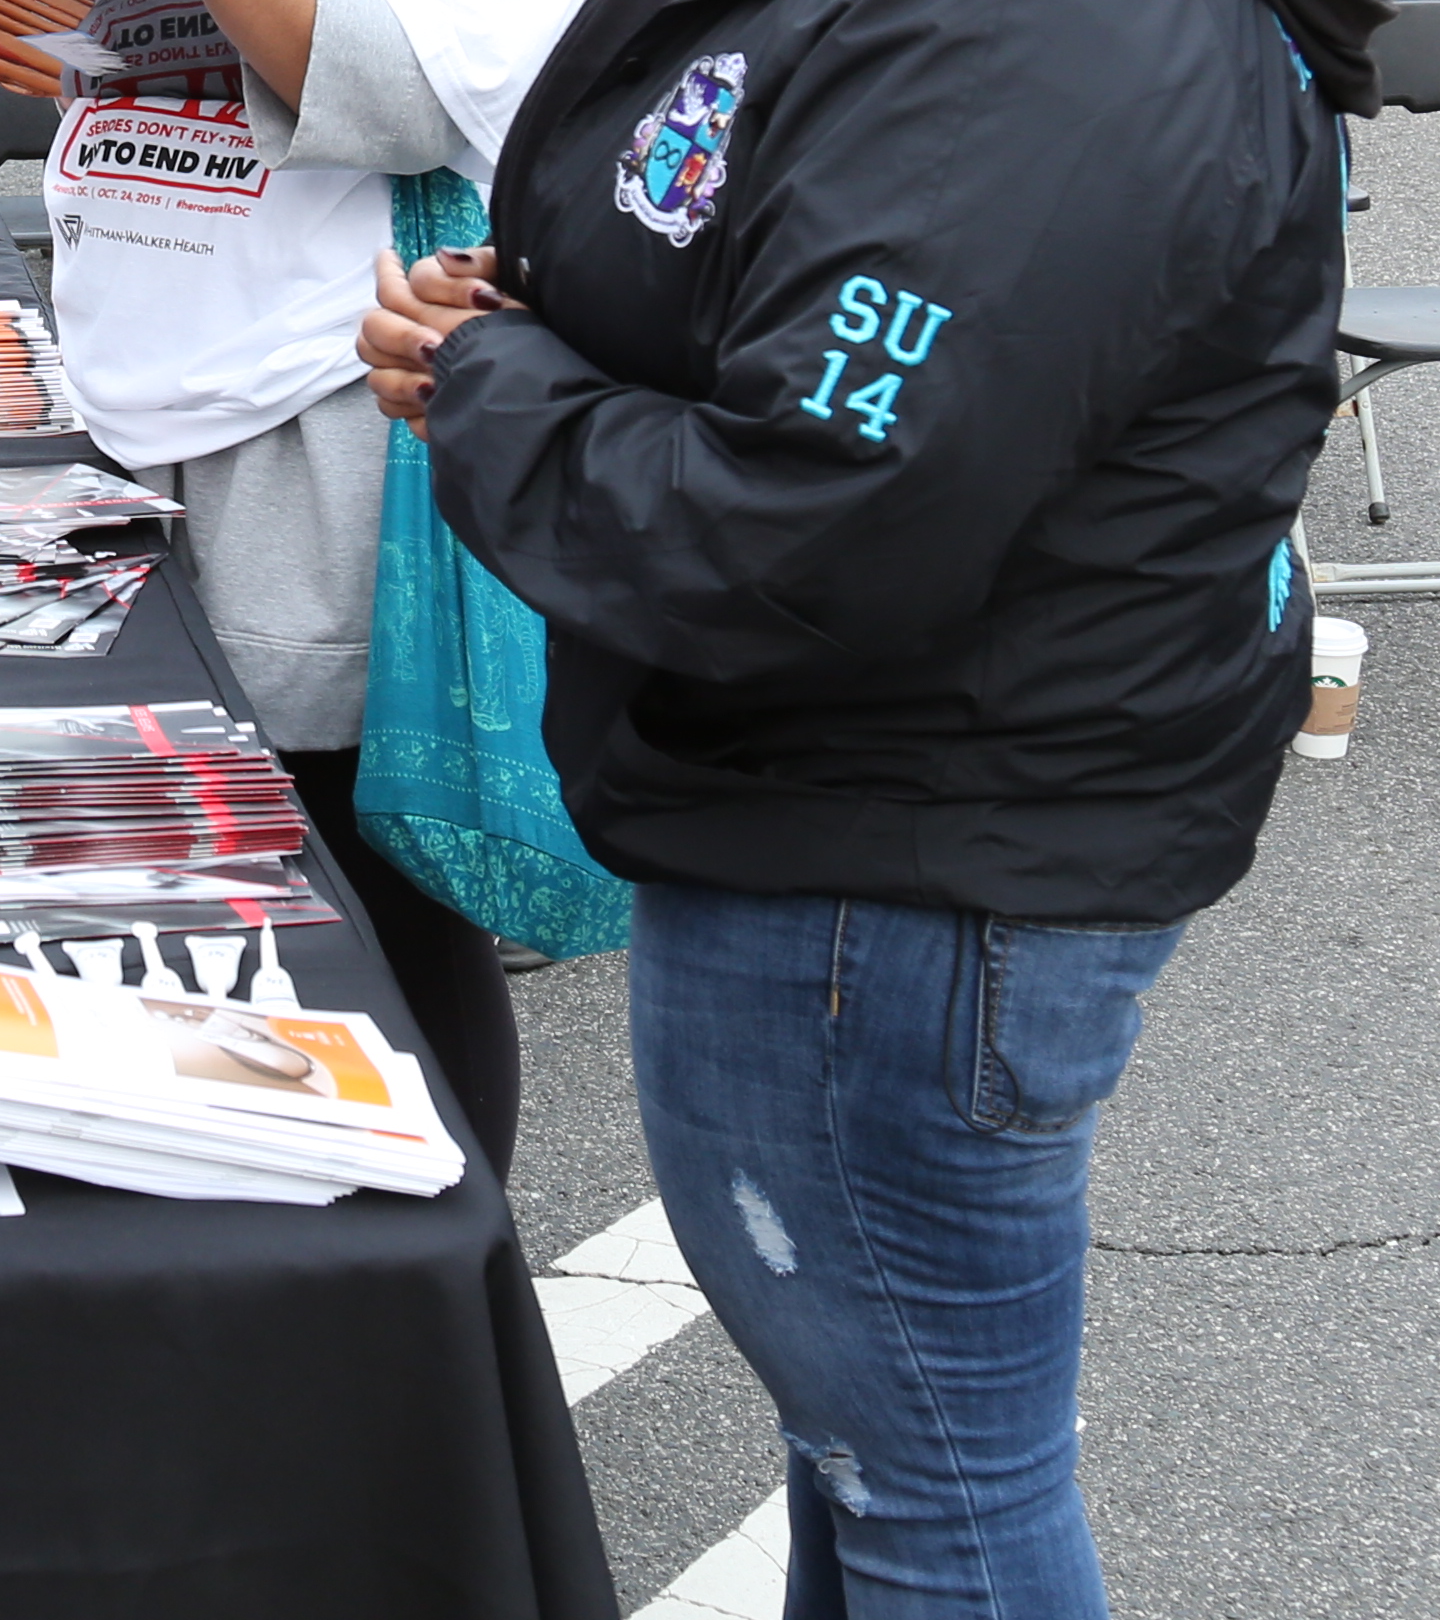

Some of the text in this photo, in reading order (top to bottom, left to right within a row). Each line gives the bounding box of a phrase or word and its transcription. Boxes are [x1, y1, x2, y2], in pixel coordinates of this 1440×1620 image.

[137, 120, 188, 142] DON'T
[190, 128, 219, 145] FLY
[139, 142, 199, 174] END
[205, 156, 260, 180] HIV
[97, 188, 118, 200] OCT.
[121, 190, 133, 203] 24,
[136, 192, 162, 206] 2015
[173, 237, 215, 256] HEALTH
[829, 274, 952, 367] SU
[800, 350, 903, 442] 14
